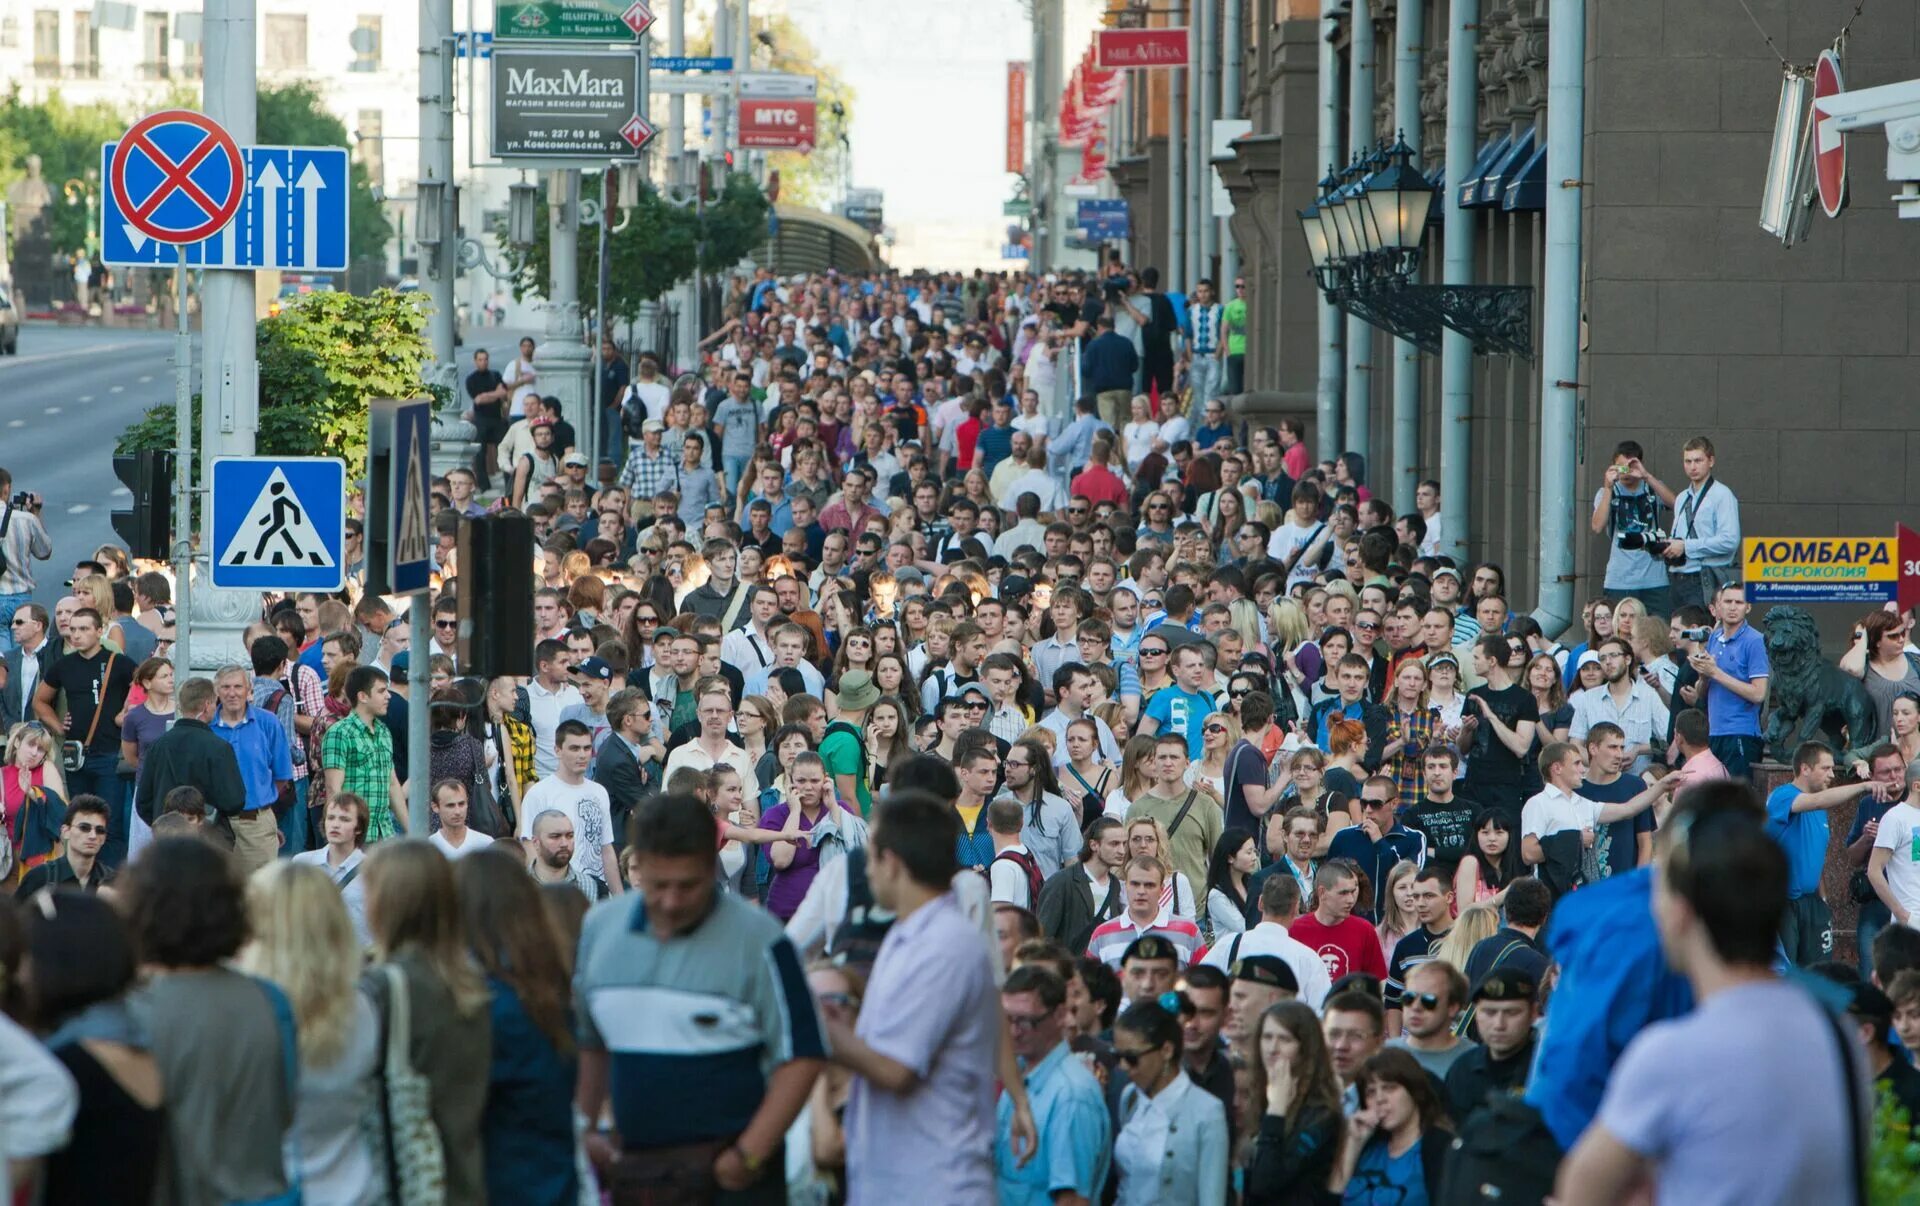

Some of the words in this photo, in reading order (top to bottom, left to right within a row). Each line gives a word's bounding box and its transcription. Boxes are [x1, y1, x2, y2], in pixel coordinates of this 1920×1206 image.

[506, 67, 624, 96] MaxMara
[505, 99, 544, 107] МАГАЗИН
[546, 99, 587, 108] ЖЕНСКОЙ
[589, 100, 625, 109] ОДЕЖДЫ
[551, 129, 569, 138] 227
[506, 140, 521, 151] ул.
[524, 140, 607, 151] Комсомольская,
[609, 141, 622, 150] 29
[1749, 541, 1890, 565] ЛОМБАРД
[1762, 565, 1868, 578] КСЕРОКОПИЯ
[1754, 583, 1768, 592] Ул.
[1770, 582, 1867, 593] Интернациональная,
[1868, 583, 1880, 592] 13
